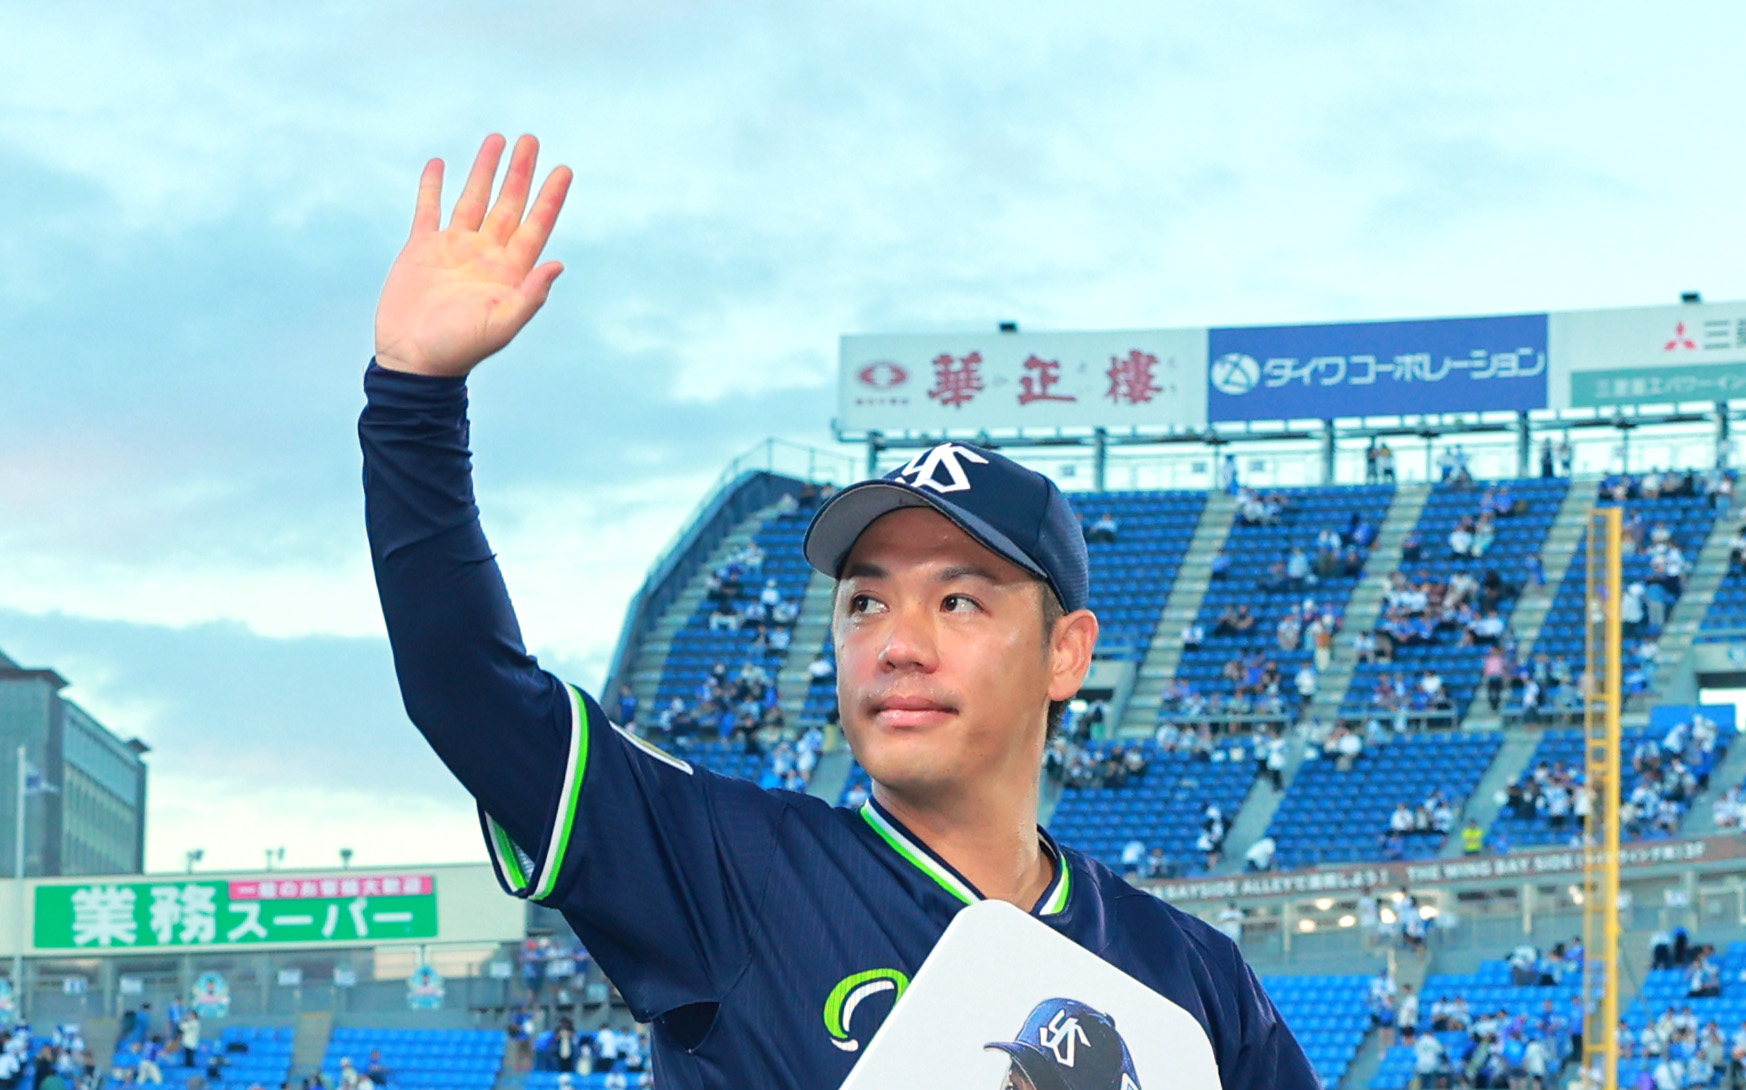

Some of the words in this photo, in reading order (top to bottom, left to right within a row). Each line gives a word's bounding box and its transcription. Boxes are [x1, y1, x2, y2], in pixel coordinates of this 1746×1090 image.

[71, 883, 413, 945] 業務スーパー
